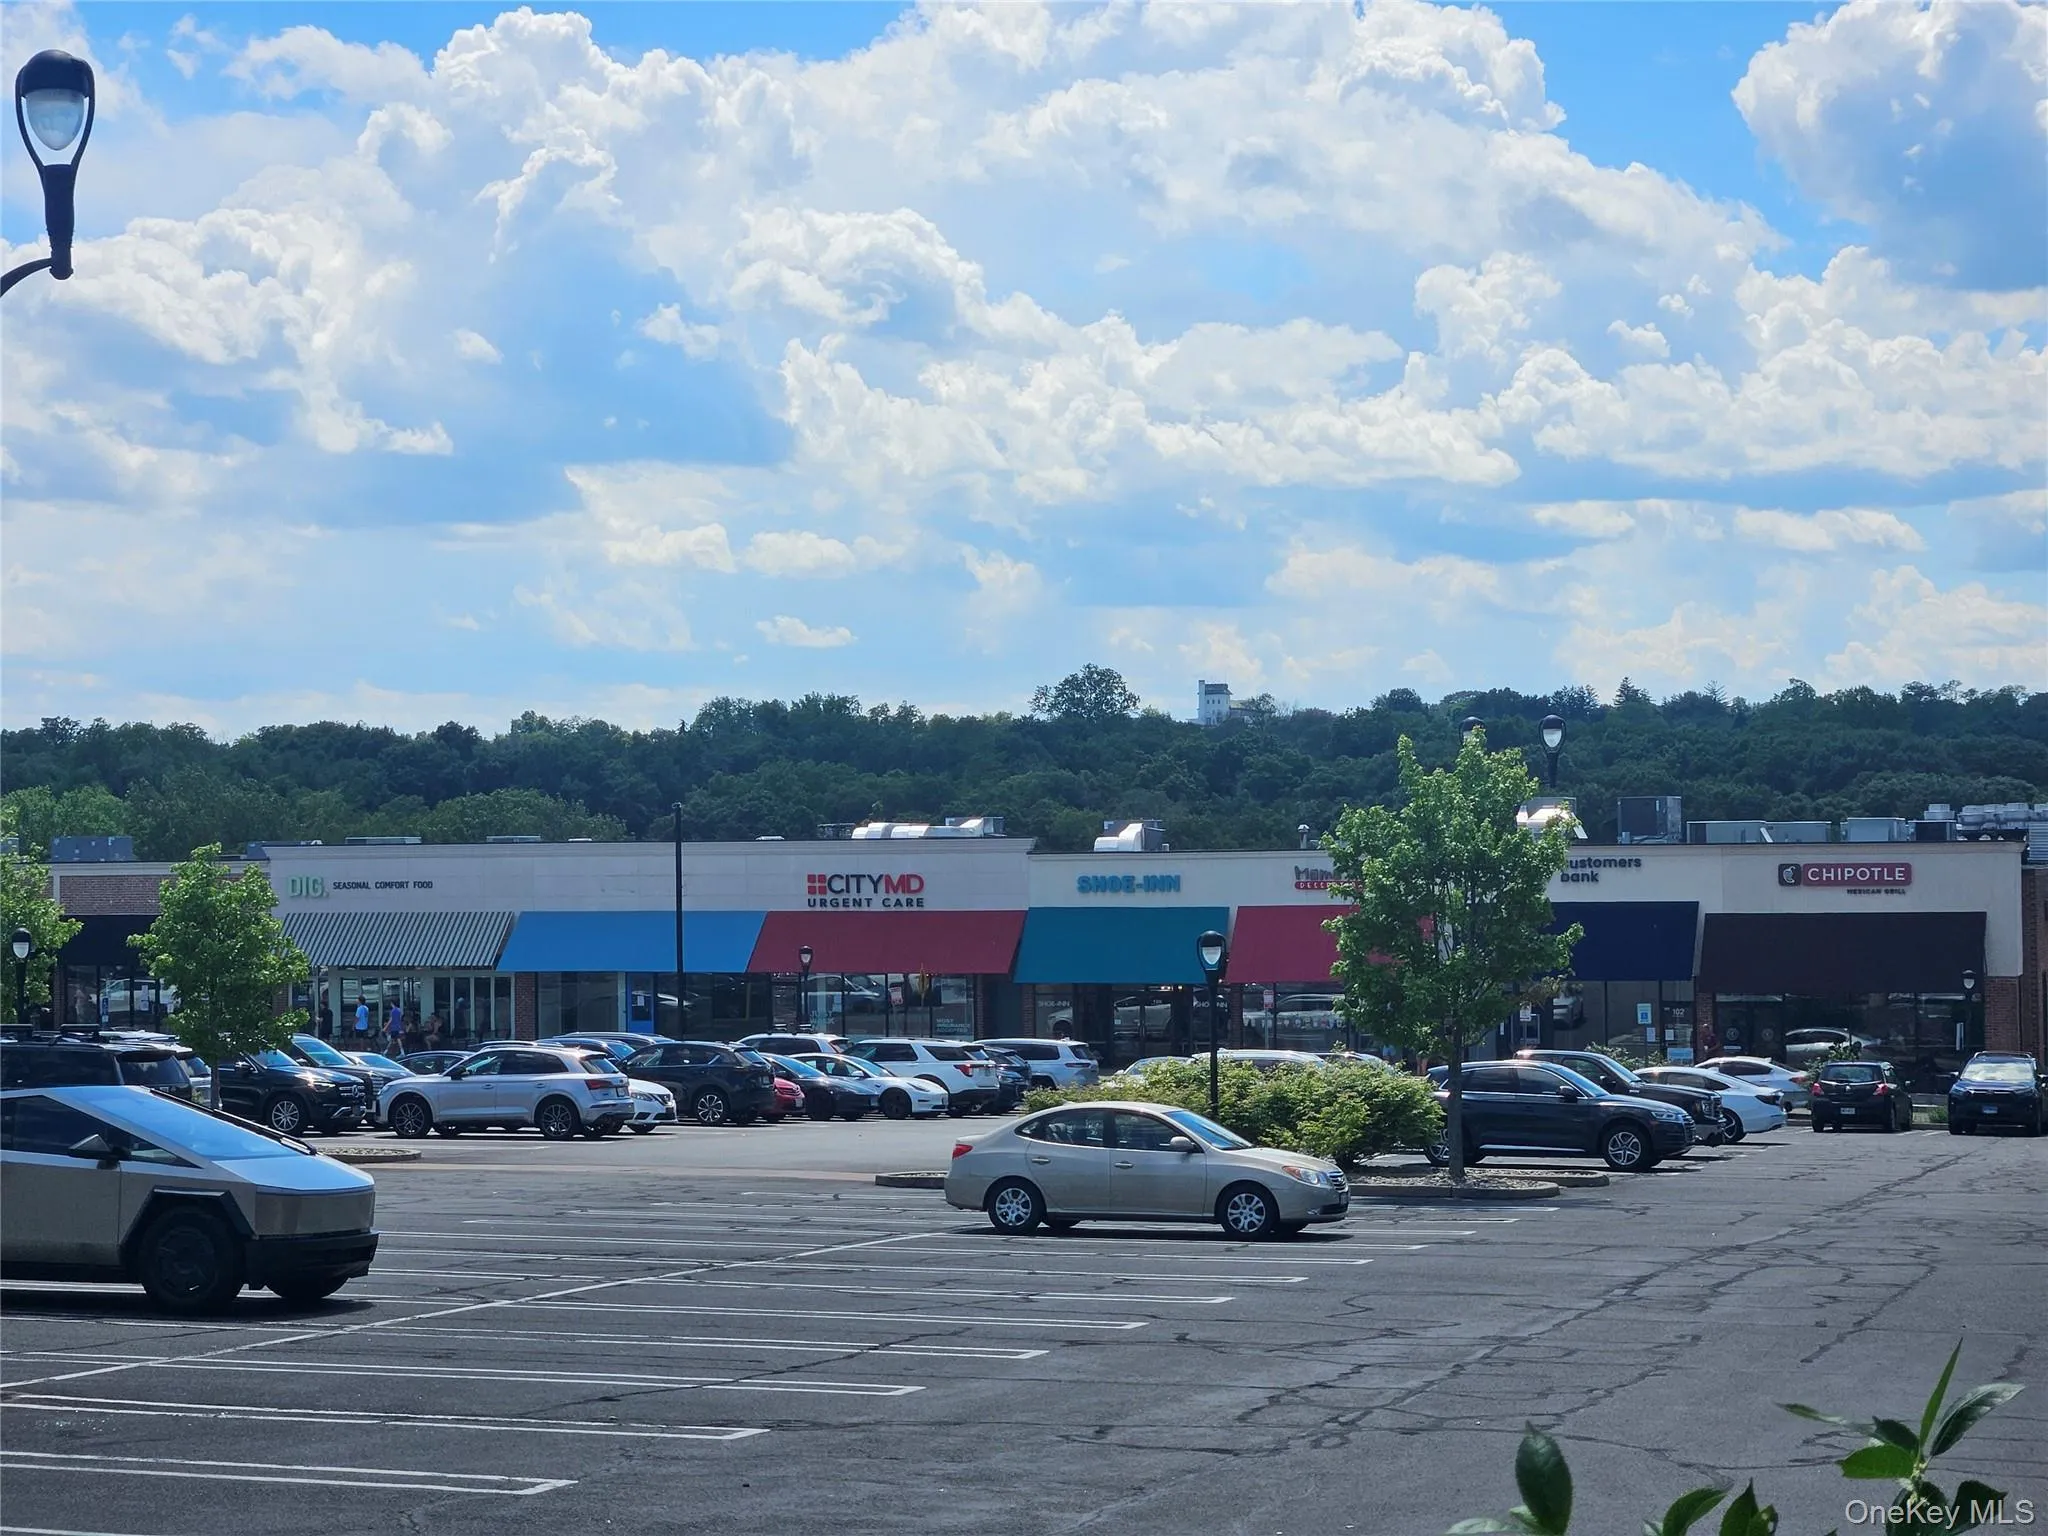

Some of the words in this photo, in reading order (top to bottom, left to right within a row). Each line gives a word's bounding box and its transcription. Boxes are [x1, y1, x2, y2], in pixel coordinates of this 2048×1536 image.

[1807, 867, 1905, 881] CHIPOTLE
[333, 881, 371, 890] SEASONAL
[374, 881, 409, 889] COMFORT
[413, 881, 434, 889] FOOD
[827, 874, 925, 894] CITYMD
[1077, 875, 1182, 893] SHOE-INN
[807, 898, 872, 908] URGENT
[882, 898, 925, 908] CARE
